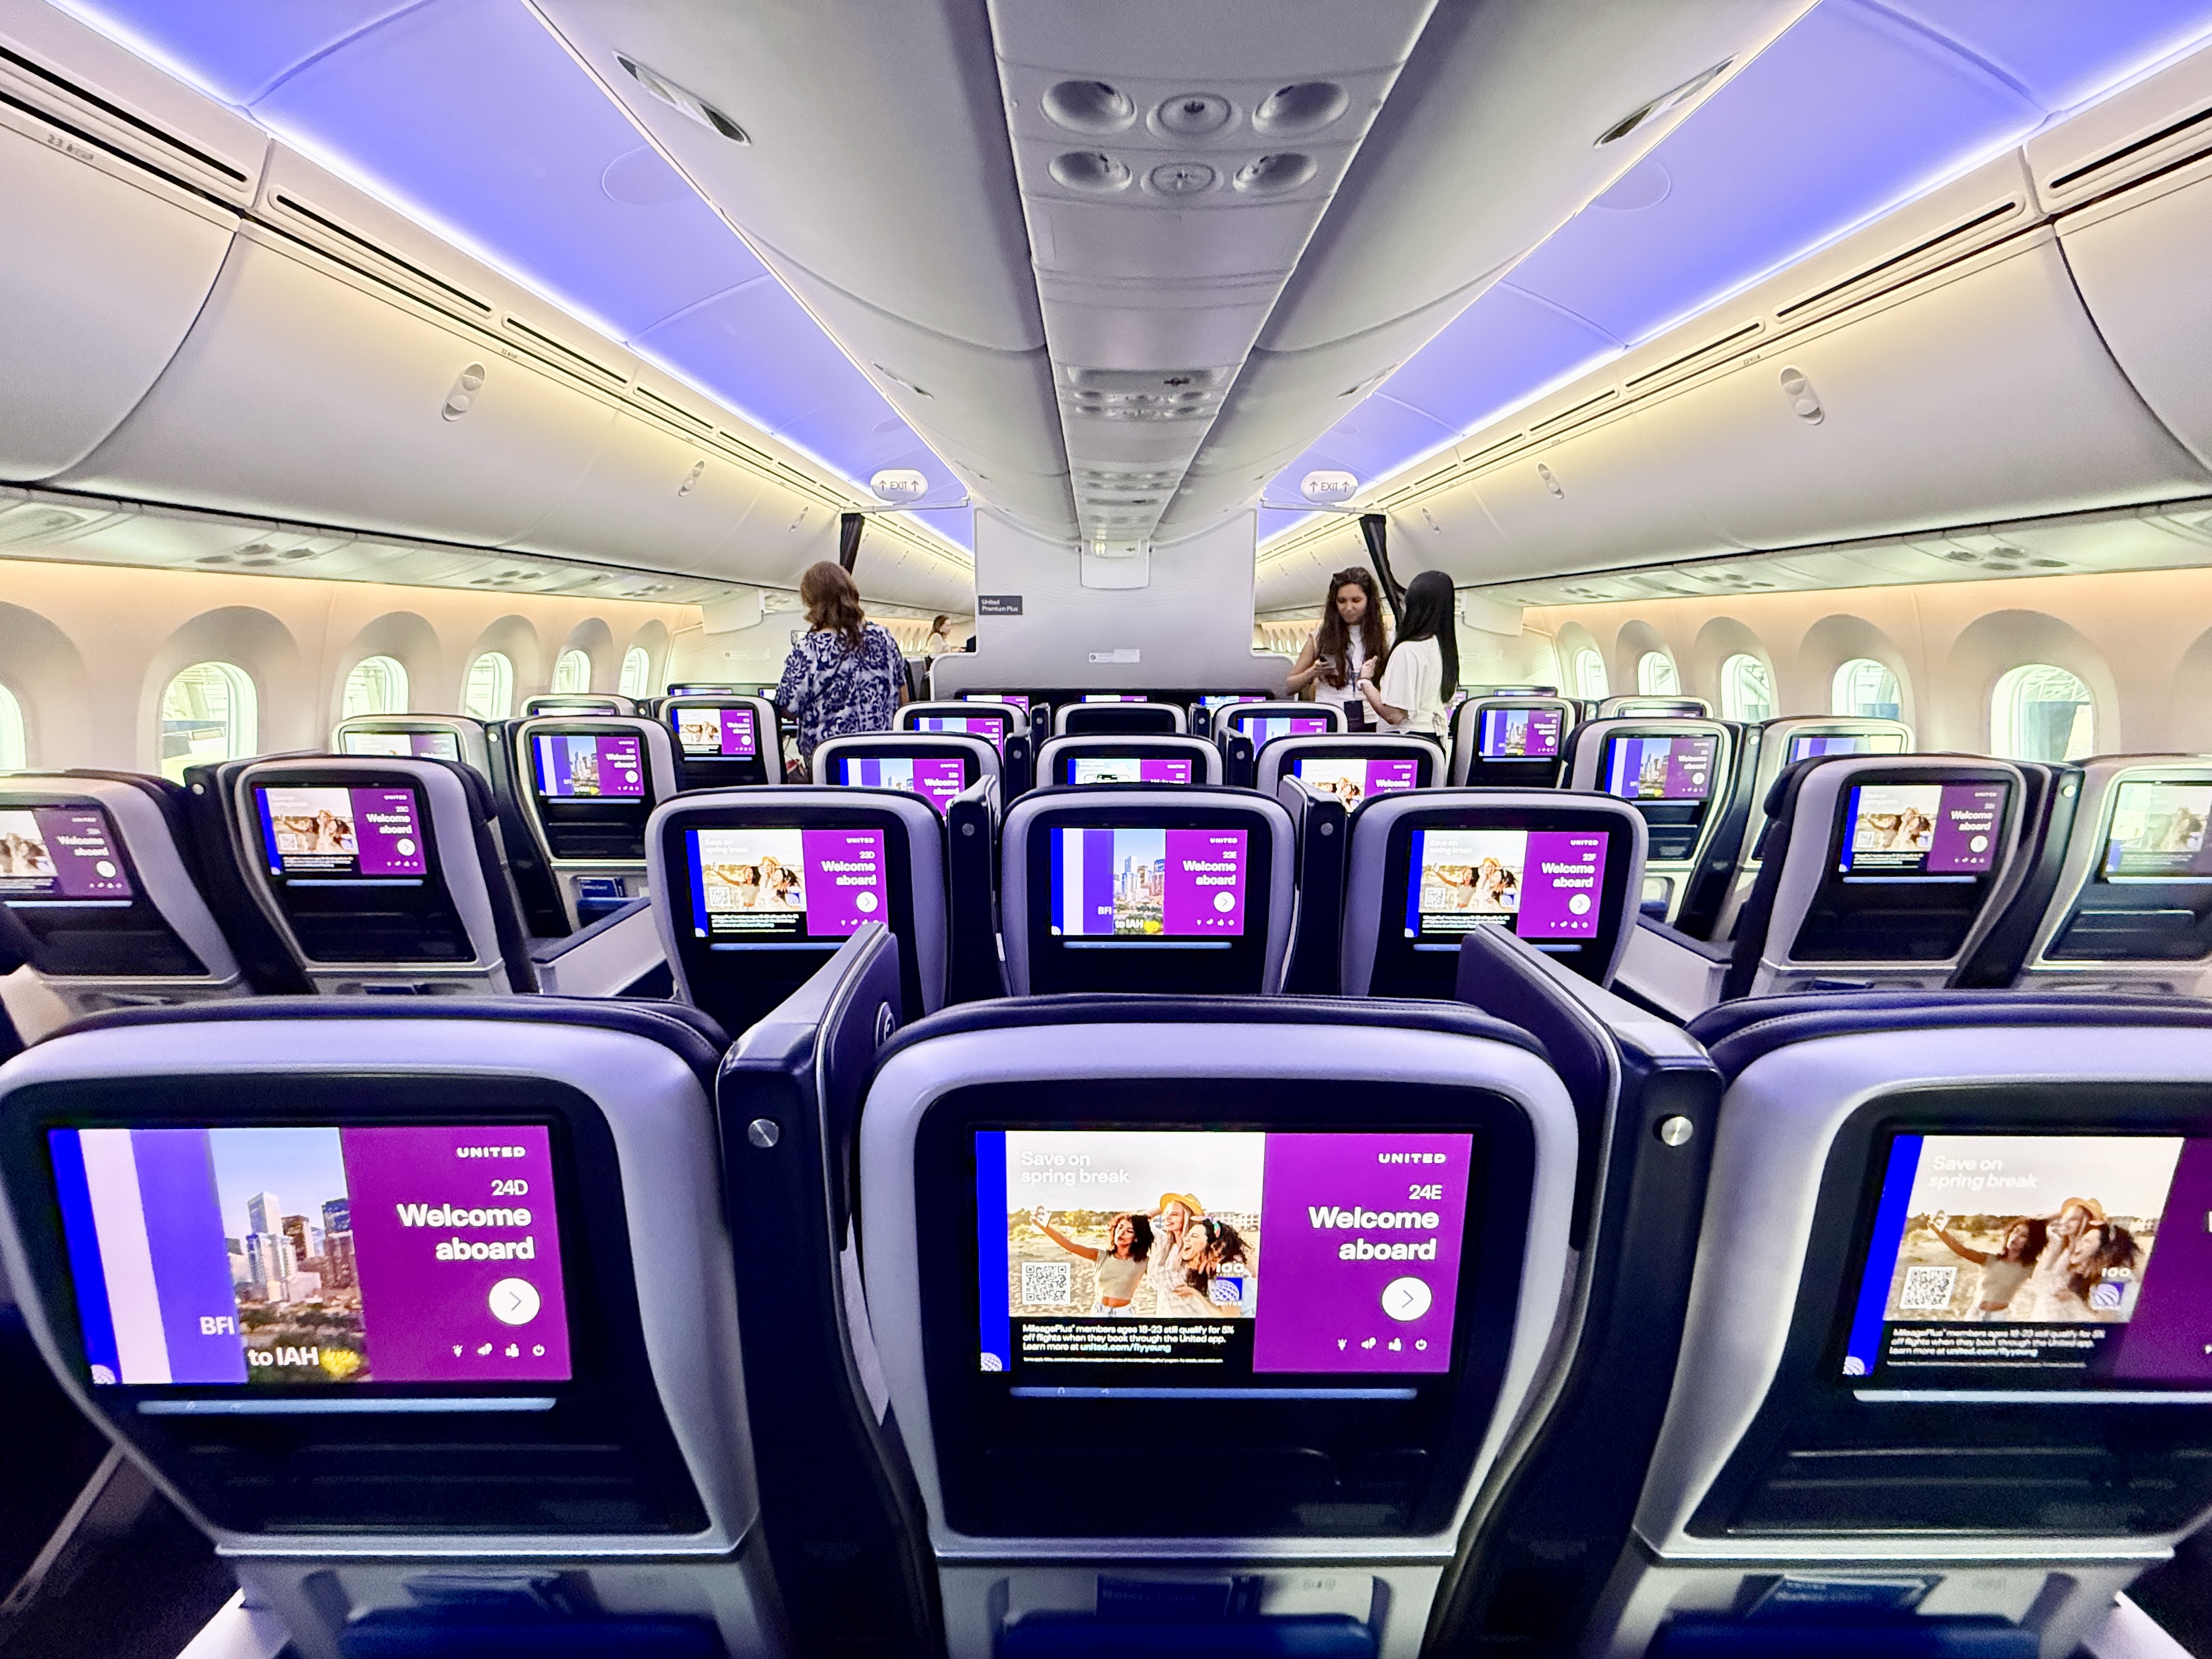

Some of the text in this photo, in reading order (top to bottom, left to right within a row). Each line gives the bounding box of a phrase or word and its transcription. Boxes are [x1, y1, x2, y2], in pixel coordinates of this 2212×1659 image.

[890, 481, 907, 490] EXIT
[1321, 482, 1339, 491] EXIT
[923, 778, 960, 787] Welcome
[1375, 778, 1410, 787] Welcome
[366, 813, 411, 823] Welcome
[1951, 810, 1994, 820] Welcome
[379, 825, 413, 834] aboard
[1959, 821, 1992, 831] aboard
[859, 851, 876, 859] 23D
[1222, 851, 1237, 859] 23E
[821, 860, 876, 872] Welcome
[1182, 860, 1237, 872] Welcome
[1541, 862, 1595, 874] Welcome
[836, 874, 877, 885] aboard
[1195, 874, 1237, 885] aboard
[1553, 876, 1594, 888] aboard
[1098, 906, 1112, 915] BFI
[1115, 918, 1144, 928] to IAH
[456, 1147, 526, 1158] UNITED
[1020, 1150, 1091, 1166] Save on
[1378, 1153, 1446, 1164] UNITED
[1933, 1155, 2002, 1171] Save on
[1021, 1168, 1130, 1187] spring break
[1928, 1172, 2038, 1191] spring break
[491, 1180, 528, 1196] 24D
[1408, 1184, 1442, 1200] 24E
[396, 1203, 532, 1227] Welcome
[1308, 1206, 1440, 1229] Welcome
[436, 1236, 535, 1261] aboard
[1339, 1238, 1437, 1260] aboard
[1216, 1262, 1245, 1273] 100
[2101, 1267, 2130, 1277] 100
[200, 1316, 235, 1335] BFI
[1076, 1324, 1116, 1333] members
[1117, 1327, 1138, 1335] ages
[1138, 1325, 1163, 1334] 18-23
[1164, 1325, 1178, 1334] still
[1179, 1325, 1207, 1335] qualify
[1208, 1325, 1221, 1334] for
[1221, 1325, 1234, 1334] 5%
[1023, 1333, 1035, 1341] off
[1036, 1334, 1062, 1343] flights
[1062, 1334, 1086, 1342] when
[1087, 1334, 1106, 1344] they
[1107, 1334, 1128, 1342] book
[1129, 1334, 1163, 1344] through
[1179, 1334, 1207, 1343] United
[1207, 1336, 1227, 1345] app.
[1023, 1342, 1046, 1351] Learn
[247, 1346, 319, 1366] to IAH
